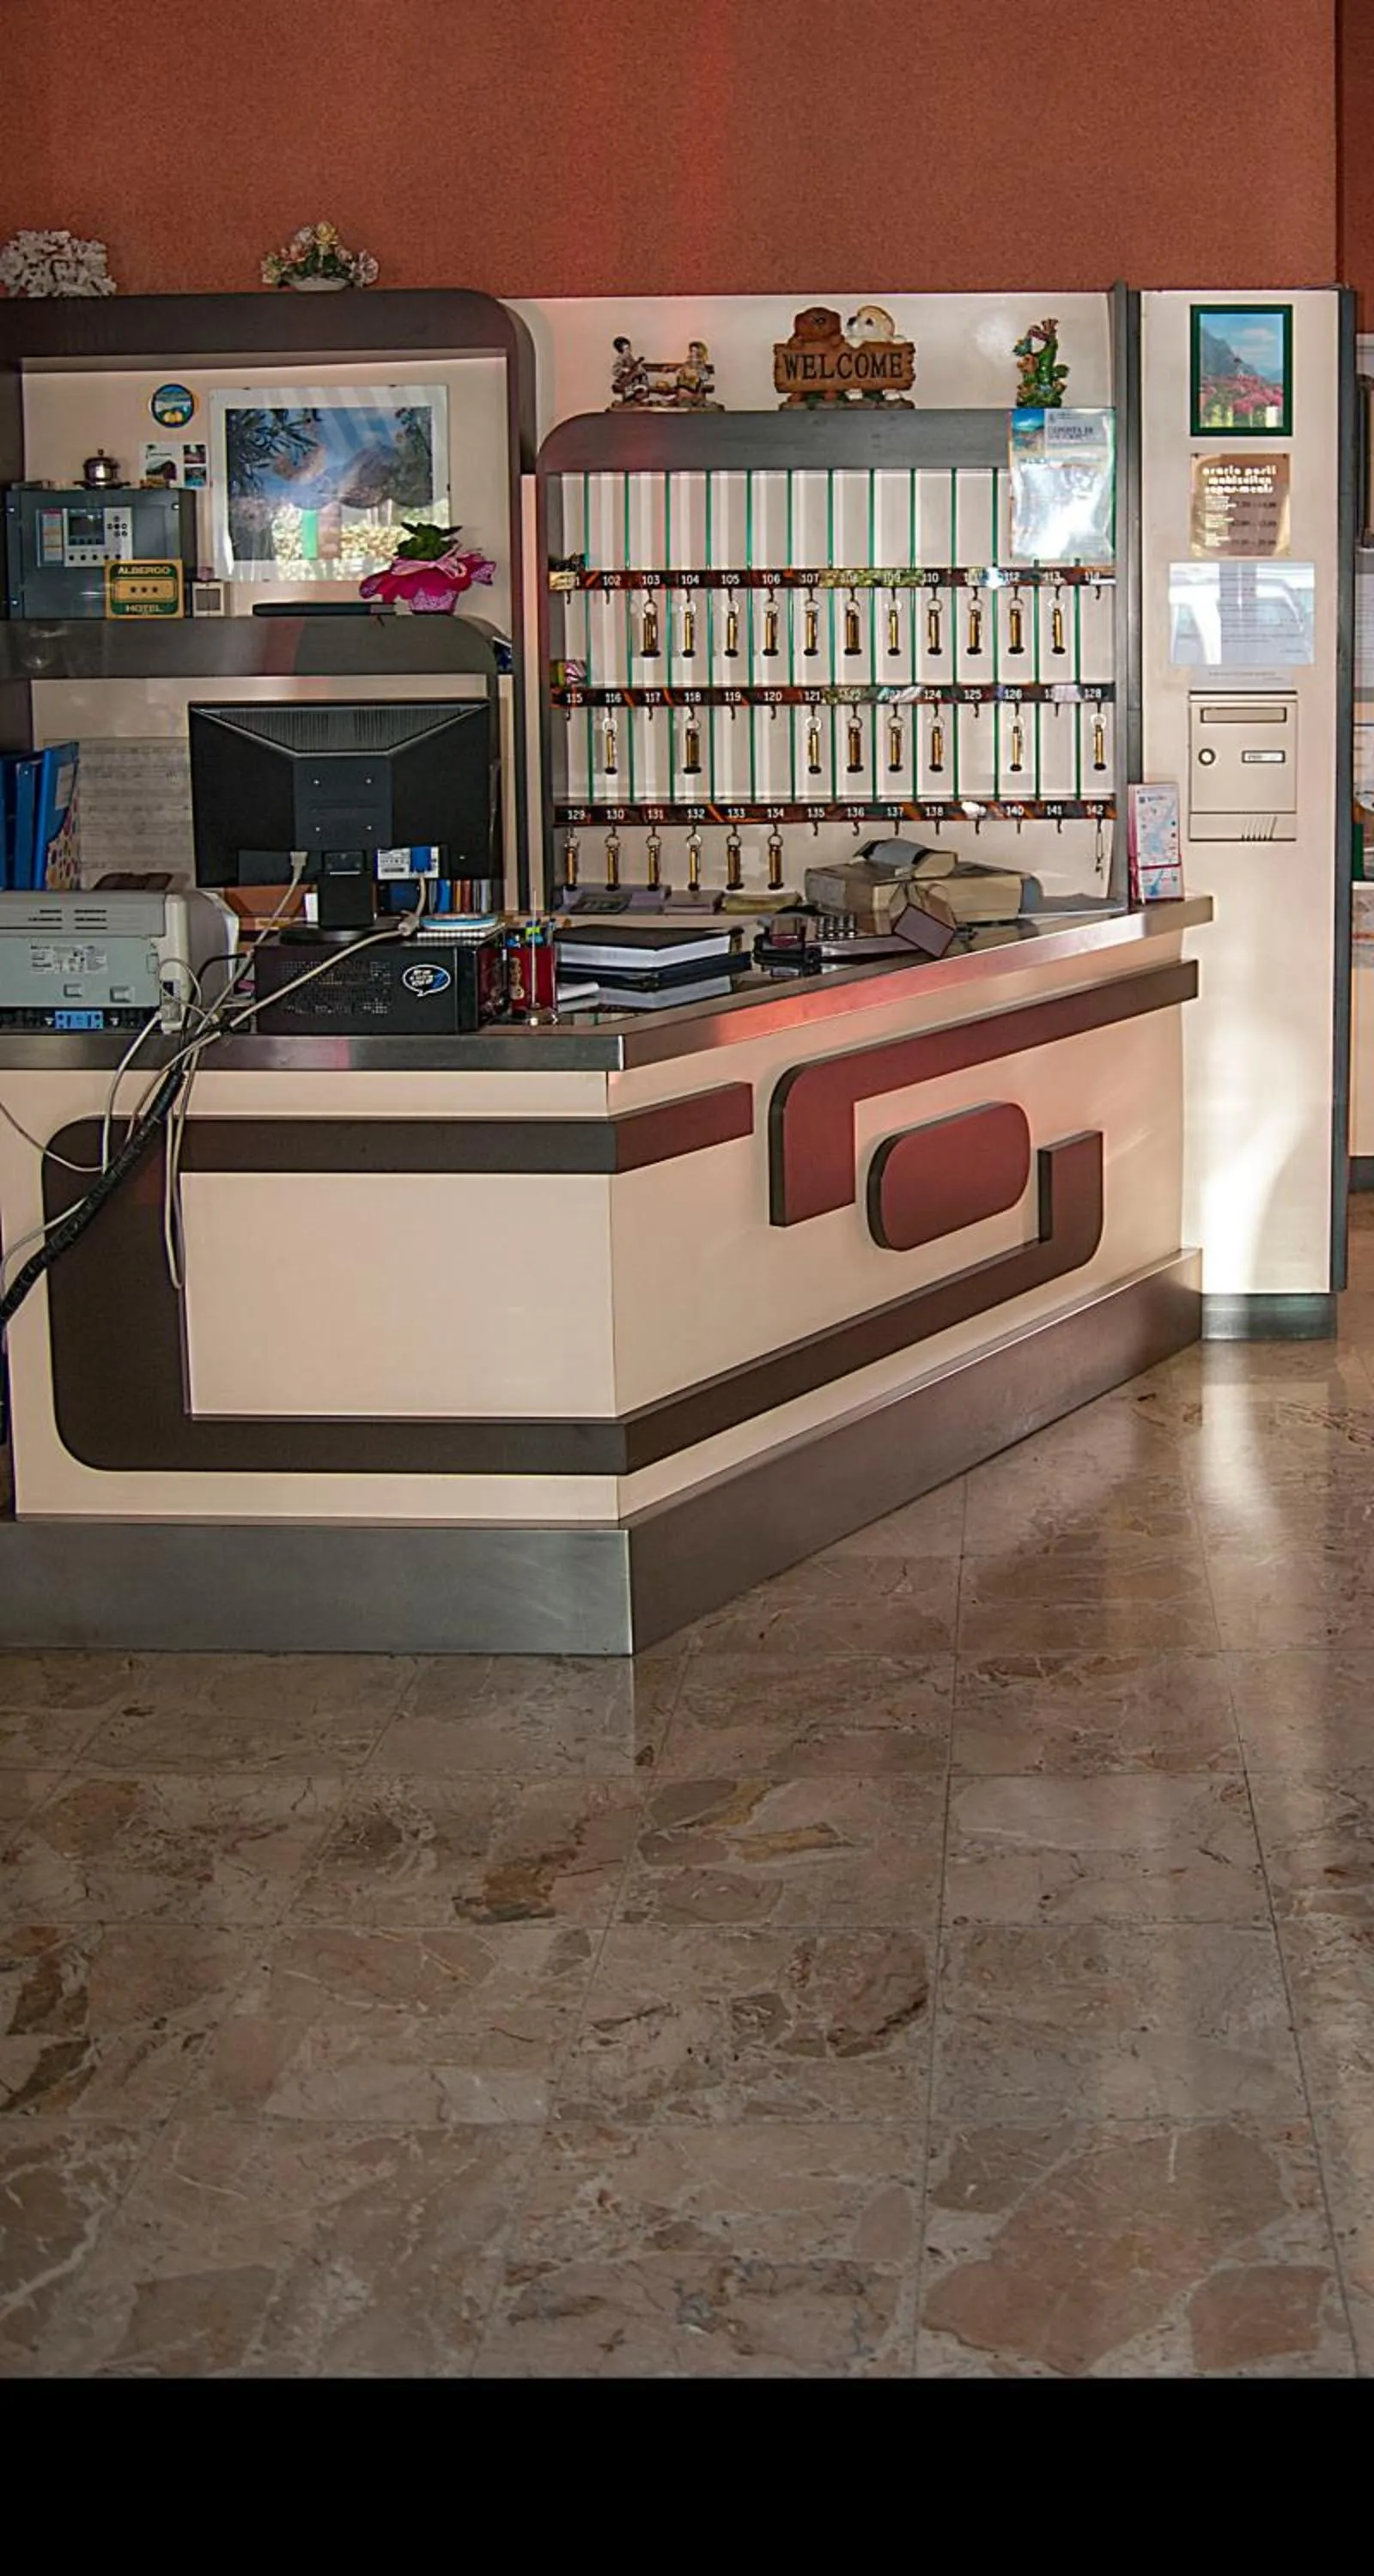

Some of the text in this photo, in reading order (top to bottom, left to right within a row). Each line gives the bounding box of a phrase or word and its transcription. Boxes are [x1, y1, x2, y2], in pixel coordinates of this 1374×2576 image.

[783, 352, 904, 380] WELCOME
[118, 566, 171, 574] ALBERGO
[603, 574, 622, 586] 102
[642, 574, 660, 585] 103
[681, 574, 700, 585] 104
[721, 574, 741, 585] 105
[762, 574, 781, 584] 106
[800, 573, 820, 584] 107
[921, 572, 939, 582] 110
[1043, 571, 1061, 581] 113
[125, 604, 164, 612] HOTEL
[566, 692, 583, 703] 115
[605, 692, 623, 703] 116
[645, 692, 661, 702] 117
[684, 691, 702, 702] 118
[724, 690, 742, 702] 119
[763, 690, 782, 702] 120
[804, 690, 821, 701] 121
[924, 690, 941, 699] 124
[964, 689, 982, 699] 125
[1004, 689, 1022, 699] 126
[1084, 688, 1102, 698] 128
[567, 805, 1103, 820] 129 130 131 132 133 134 135 136 137 138 140 141 142
